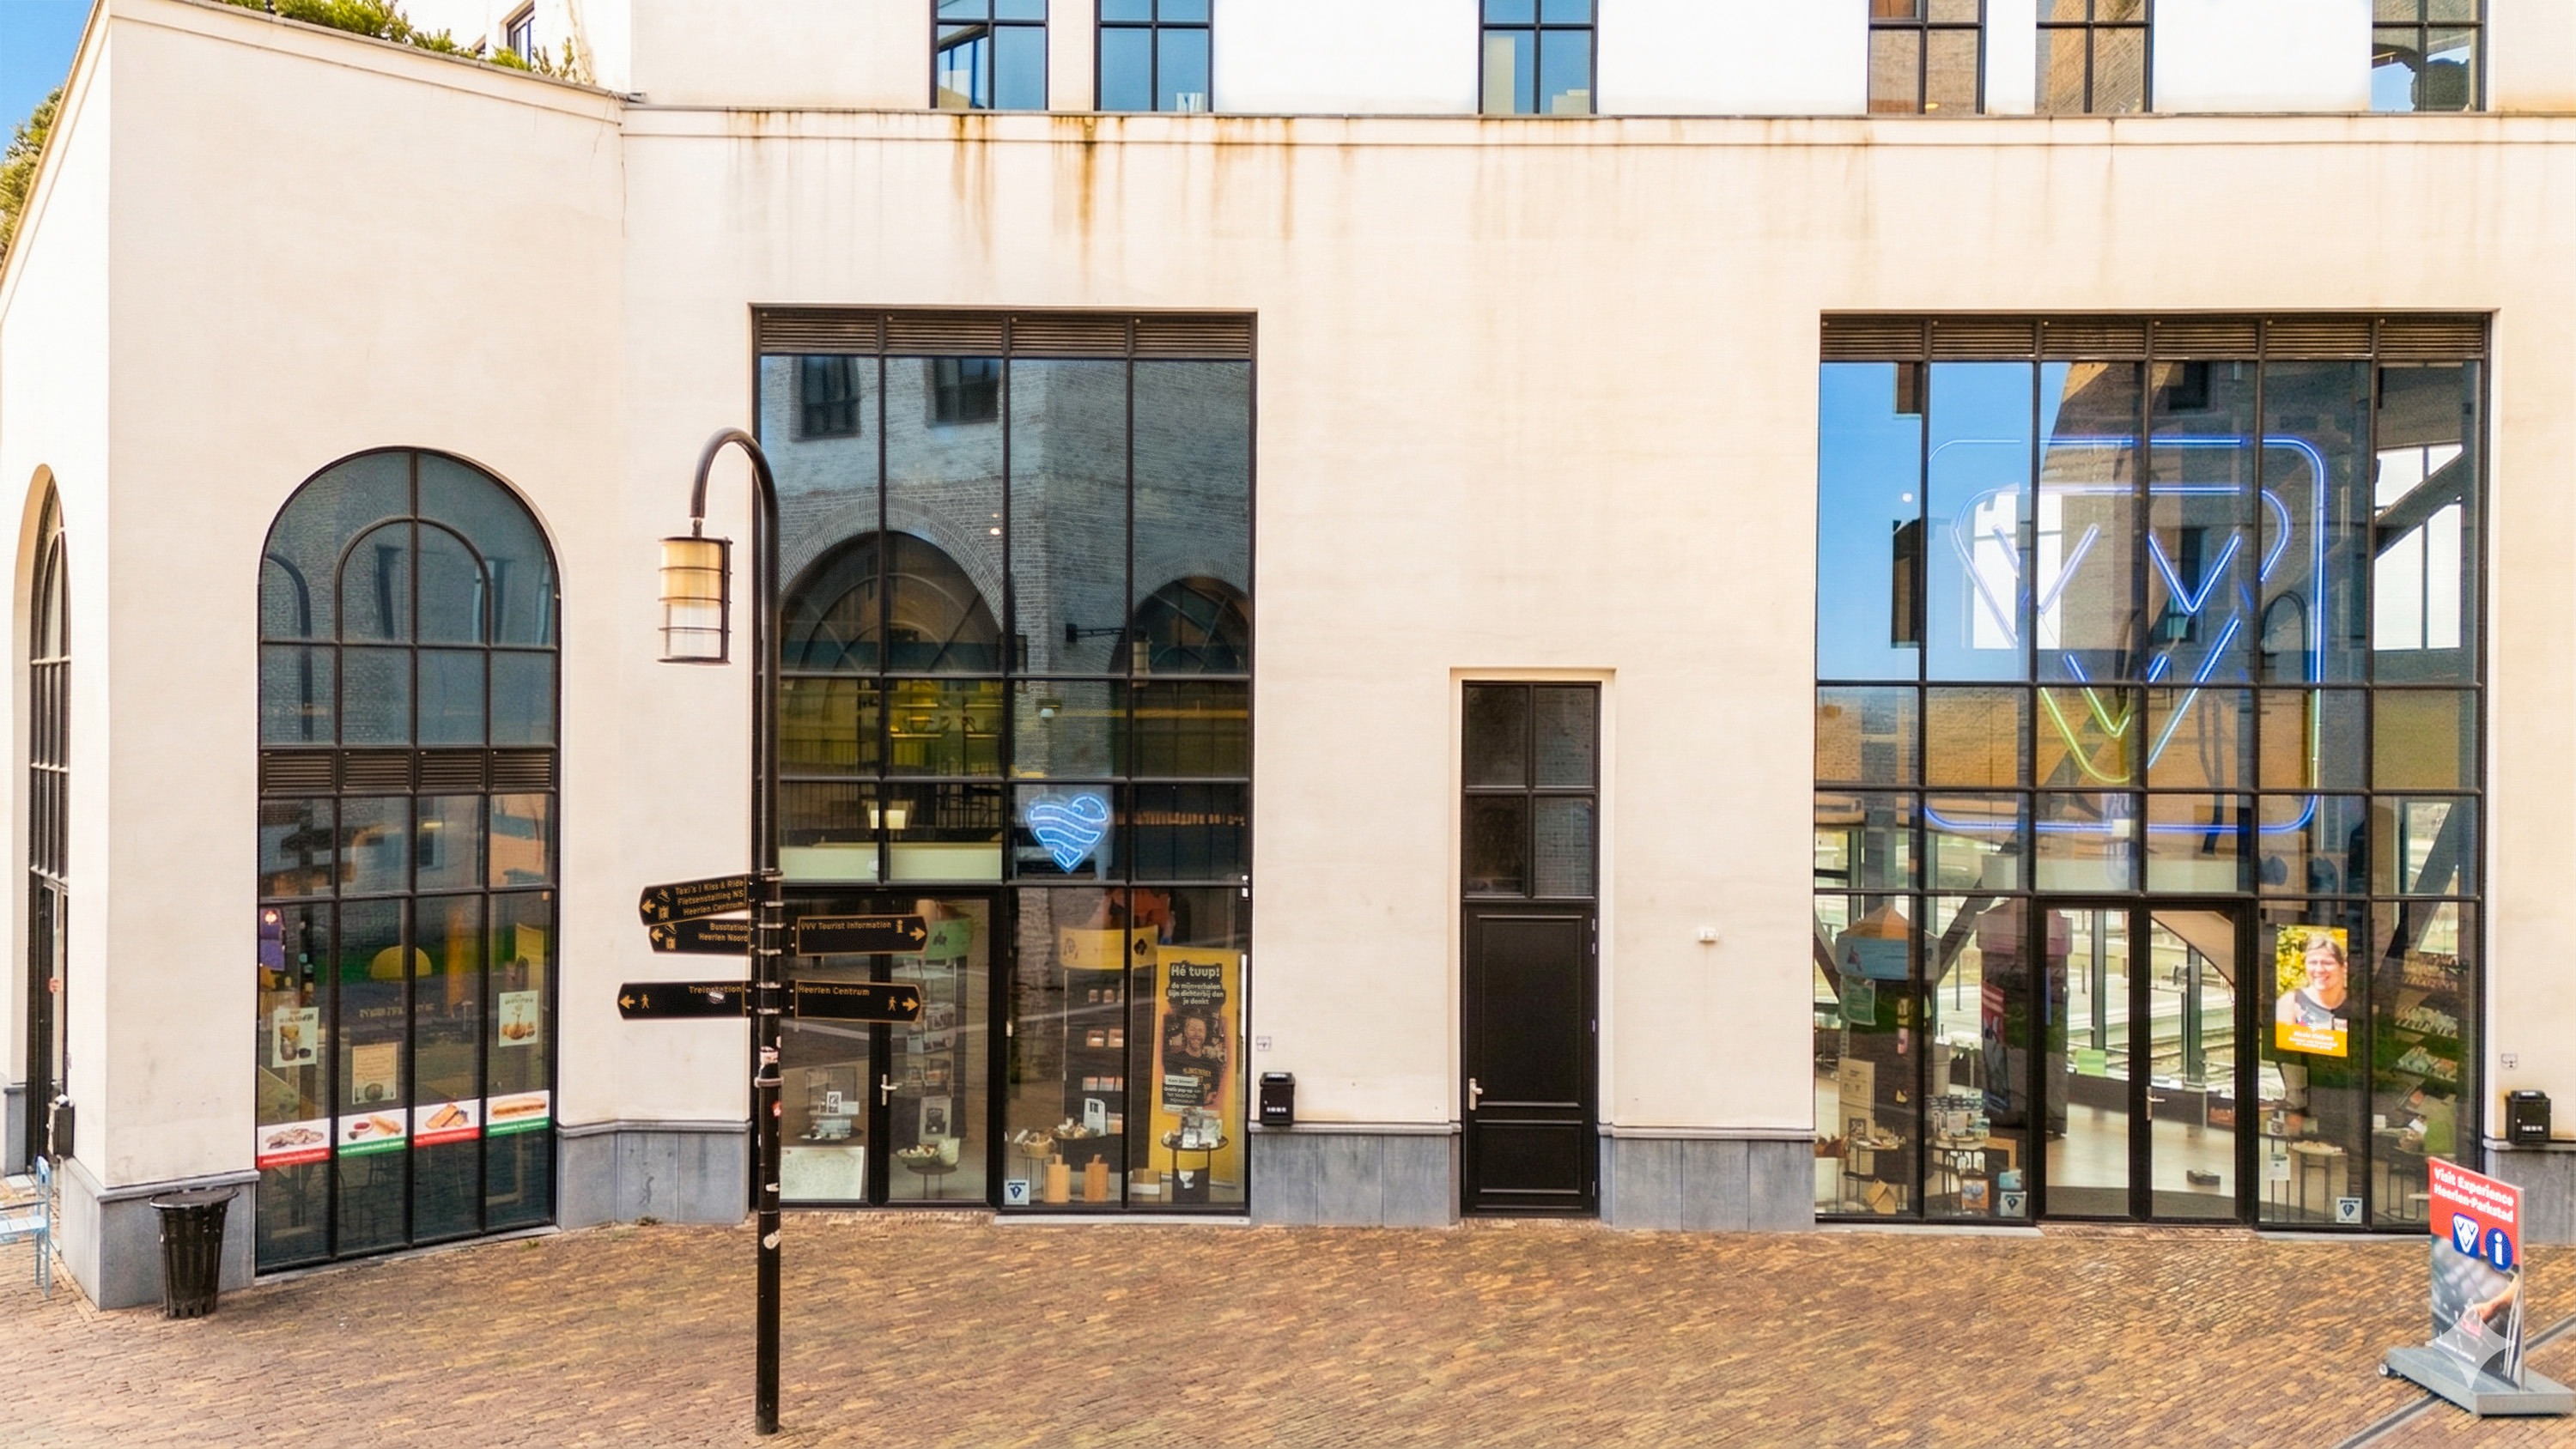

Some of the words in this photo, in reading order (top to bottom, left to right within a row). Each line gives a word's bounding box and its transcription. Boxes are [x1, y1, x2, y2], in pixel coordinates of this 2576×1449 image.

[675, 886, 696, 895] Taxi's
[703, 882, 719, 891] Kiss
[727, 879, 744, 888] Ride
[677, 892, 732, 906] Fietsenstalling
[683, 906, 711, 916] Heerlen
[713, 901, 744, 911] Centrum
[709, 922, 748, 931] Busstation
[800, 921, 816, 930] VVV
[818, 921, 845, 930] Tourist
[847, 920, 892, 930] Information
[1170, 964, 1186, 977] Hé
[1188, 967, 1220, 979] tuup!
[799, 985, 830, 994] Heerlen
[833, 986, 870, 996] Centrum
[1181, 989, 1212, 998] dichterbij
[2433, 1167, 2456, 1186] Visit
[2458, 1176, 2514, 1207] Experience
[2433, 1184, 2514, 1222] Heerlen-Parkstad
